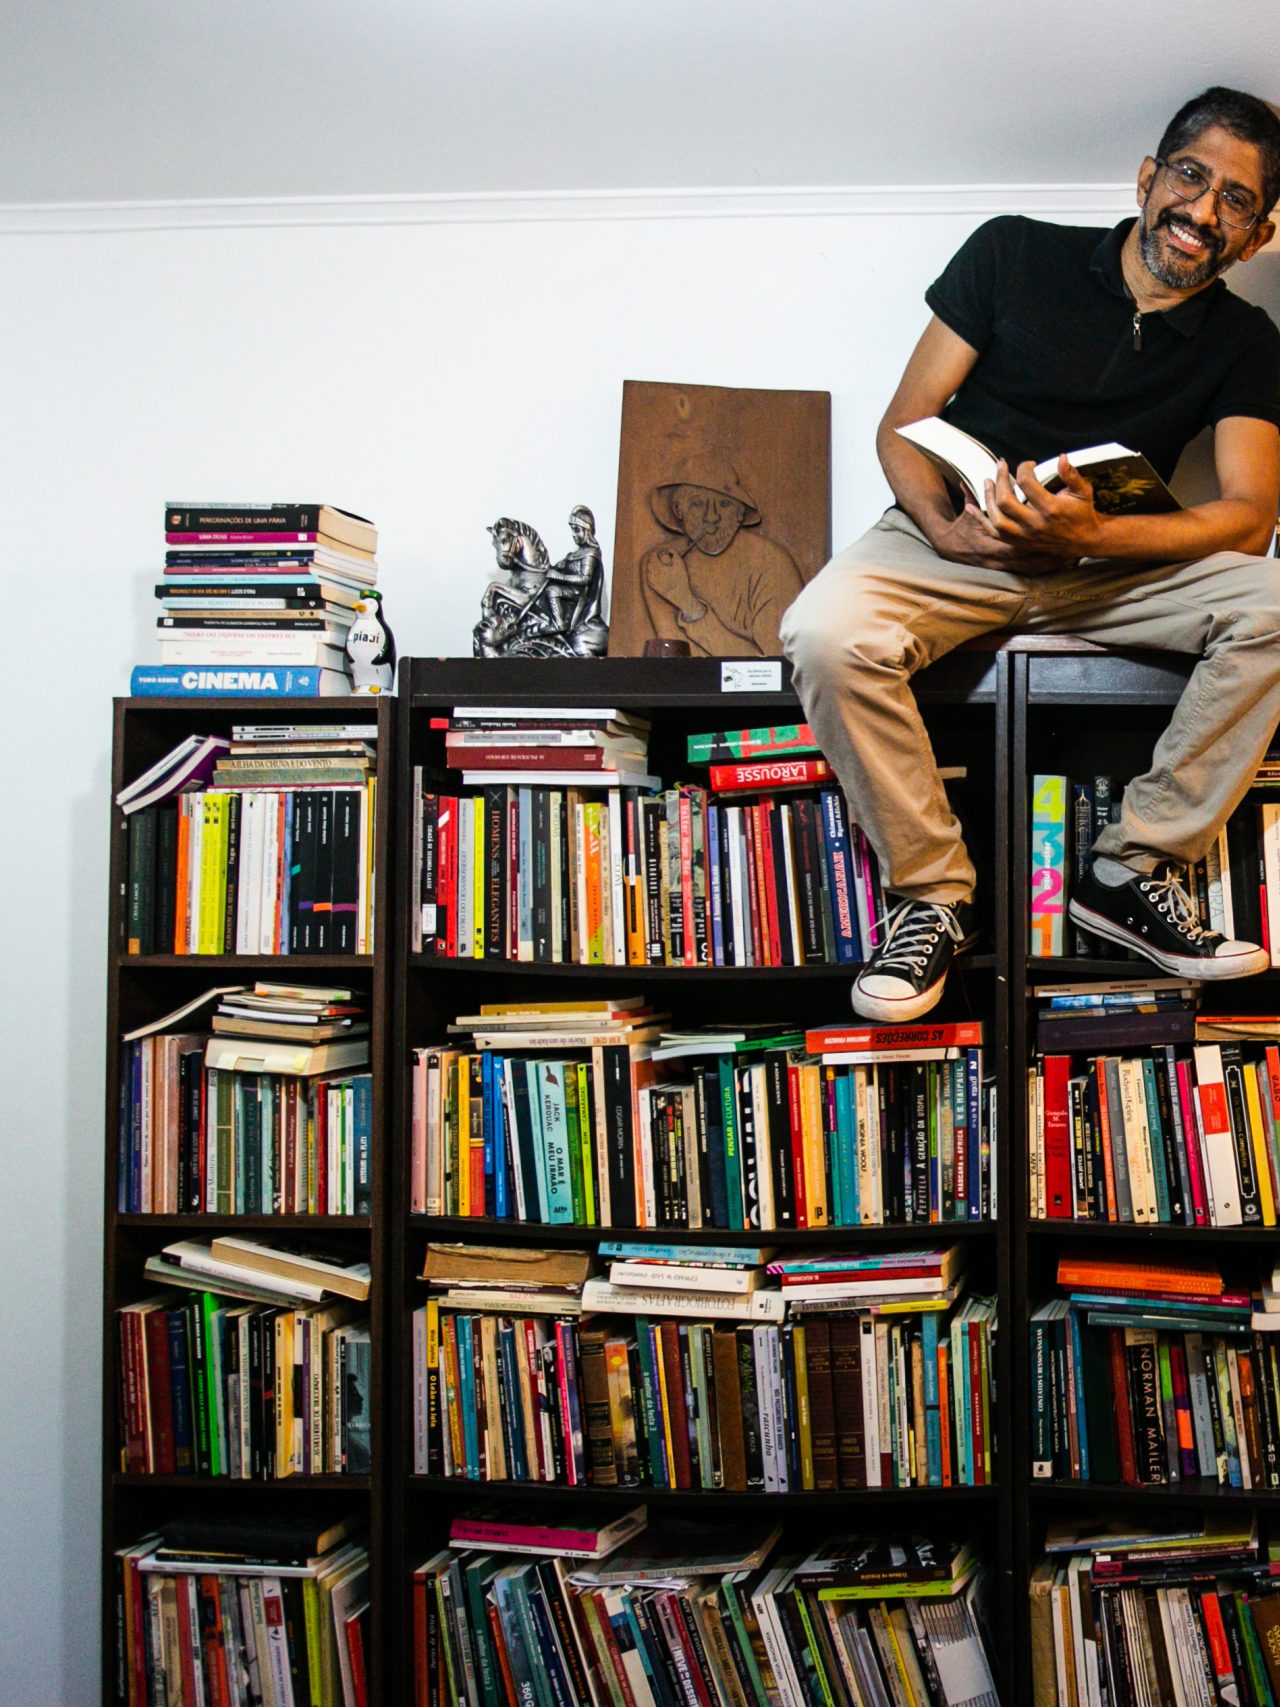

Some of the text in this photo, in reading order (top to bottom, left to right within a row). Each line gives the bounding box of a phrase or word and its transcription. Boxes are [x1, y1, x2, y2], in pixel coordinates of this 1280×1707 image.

[181, 672, 278, 690] CINEMA
[736, 762, 807, 783] LAROUSSE
[491, 810, 500, 943] HOMENS ELEGANTES
[1032, 776, 1065, 957] 4 3 2 1
[1043, 871, 1051, 890] paul
[875, 1030, 944, 1044] AS CORREÇÕES
[544, 1094, 561, 1132] JACK KEROUAC
[549, 1159, 557, 1194] IRMÃO
[1140, 1347, 1161, 1483] NORMAN MAILER
